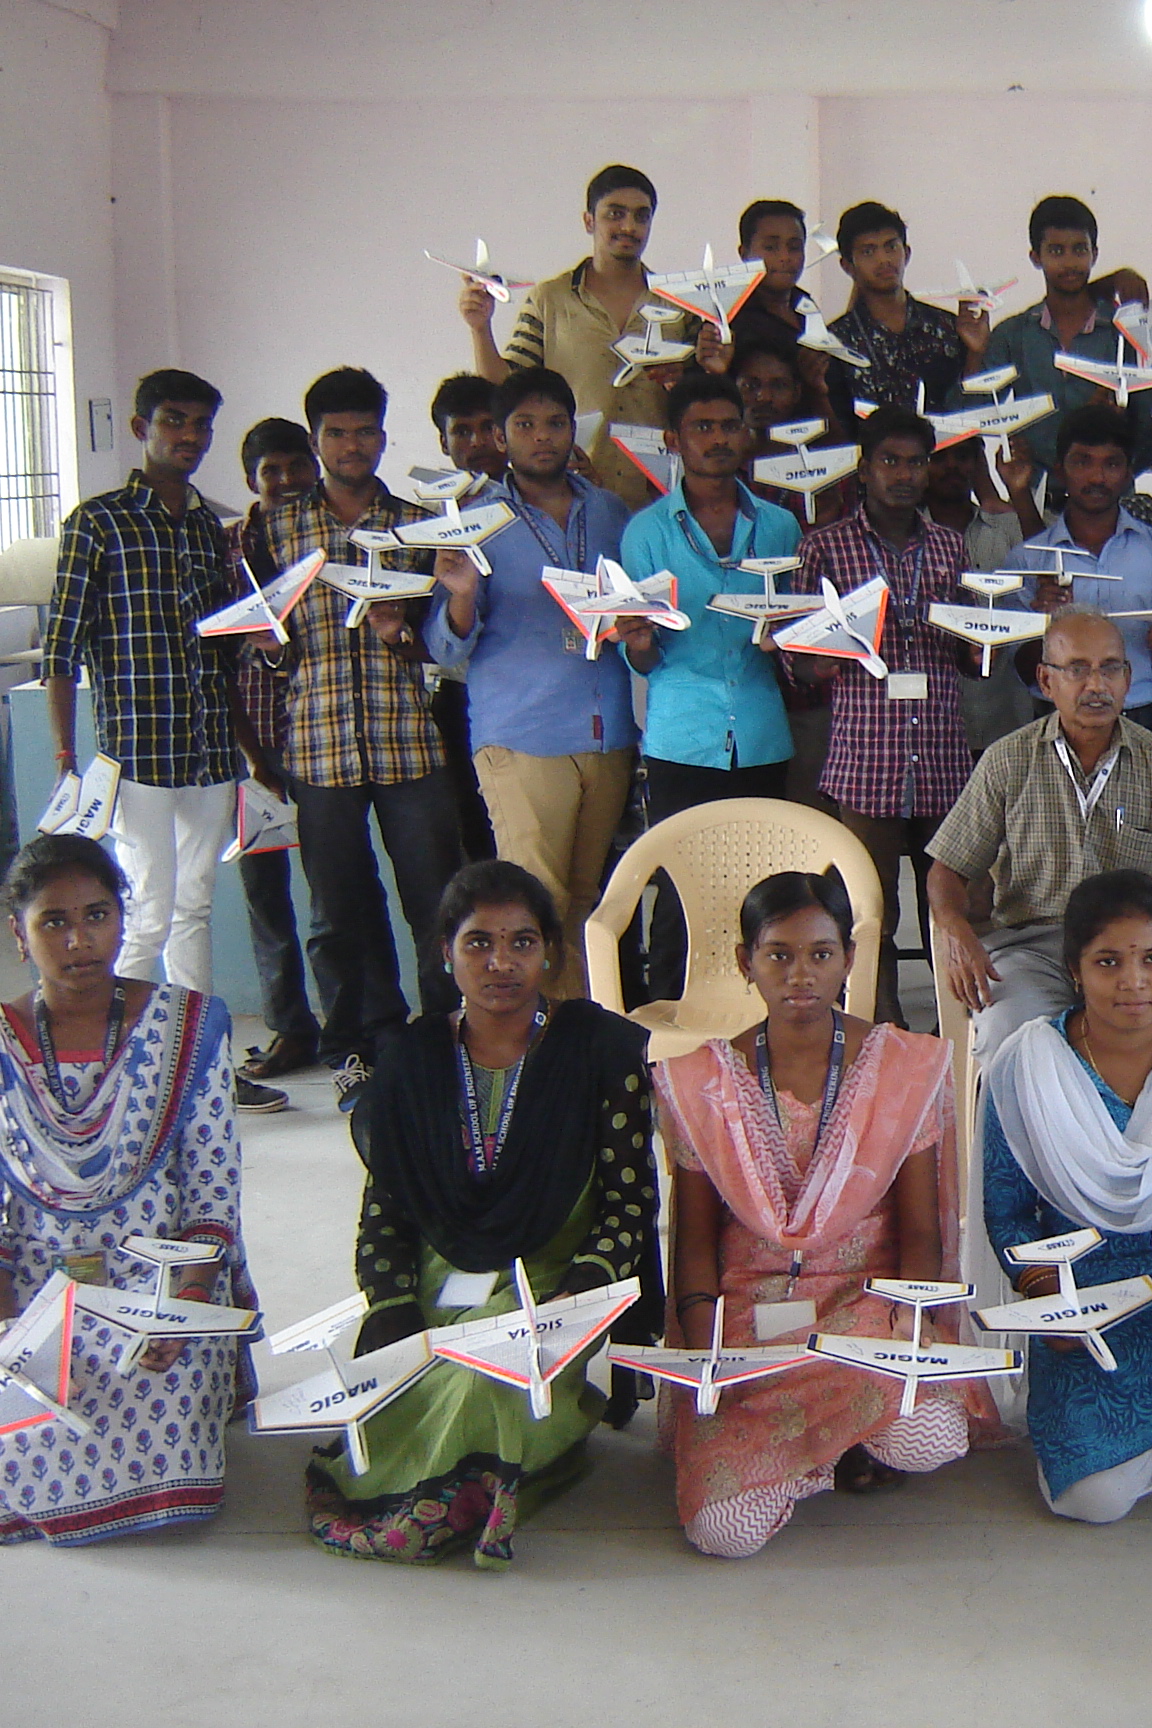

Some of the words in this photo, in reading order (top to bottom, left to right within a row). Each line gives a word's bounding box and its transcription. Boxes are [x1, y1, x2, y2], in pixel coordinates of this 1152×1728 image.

[964, 621, 1010, 634] MAGIC
[76, 798, 102, 834] MAGI
[116, 1304, 189, 1325] MAGIC
[1040, 1301, 1109, 1323] MAGIC
[0, 1347, 34, 1389] SIGM
[873, 1351, 949, 1365] MAGIC
[309, 1376, 379, 1414] MAGIC
